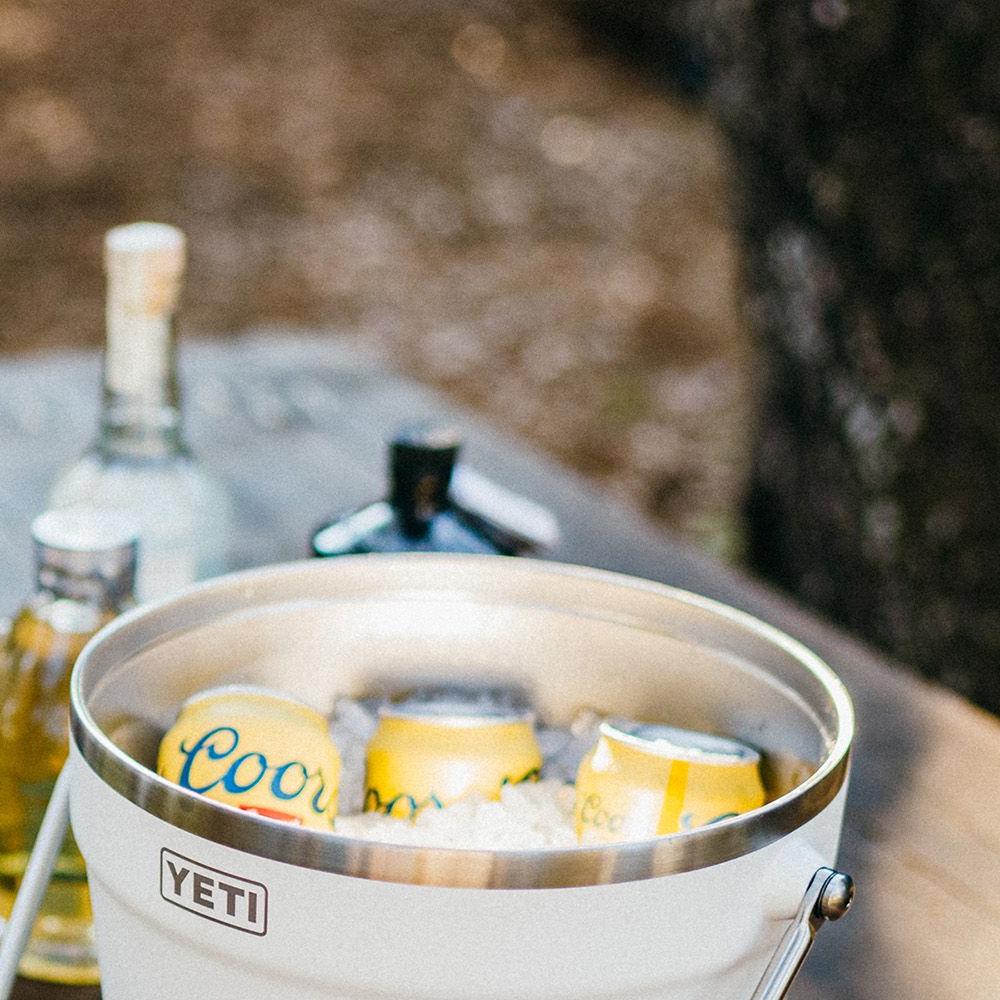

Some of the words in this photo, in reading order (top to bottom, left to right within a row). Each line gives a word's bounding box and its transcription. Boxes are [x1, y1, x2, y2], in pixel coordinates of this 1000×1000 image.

[179, 726, 337, 815] Coor
[580, 792, 627, 833] Coo
[166, 859, 258, 924] YETI
